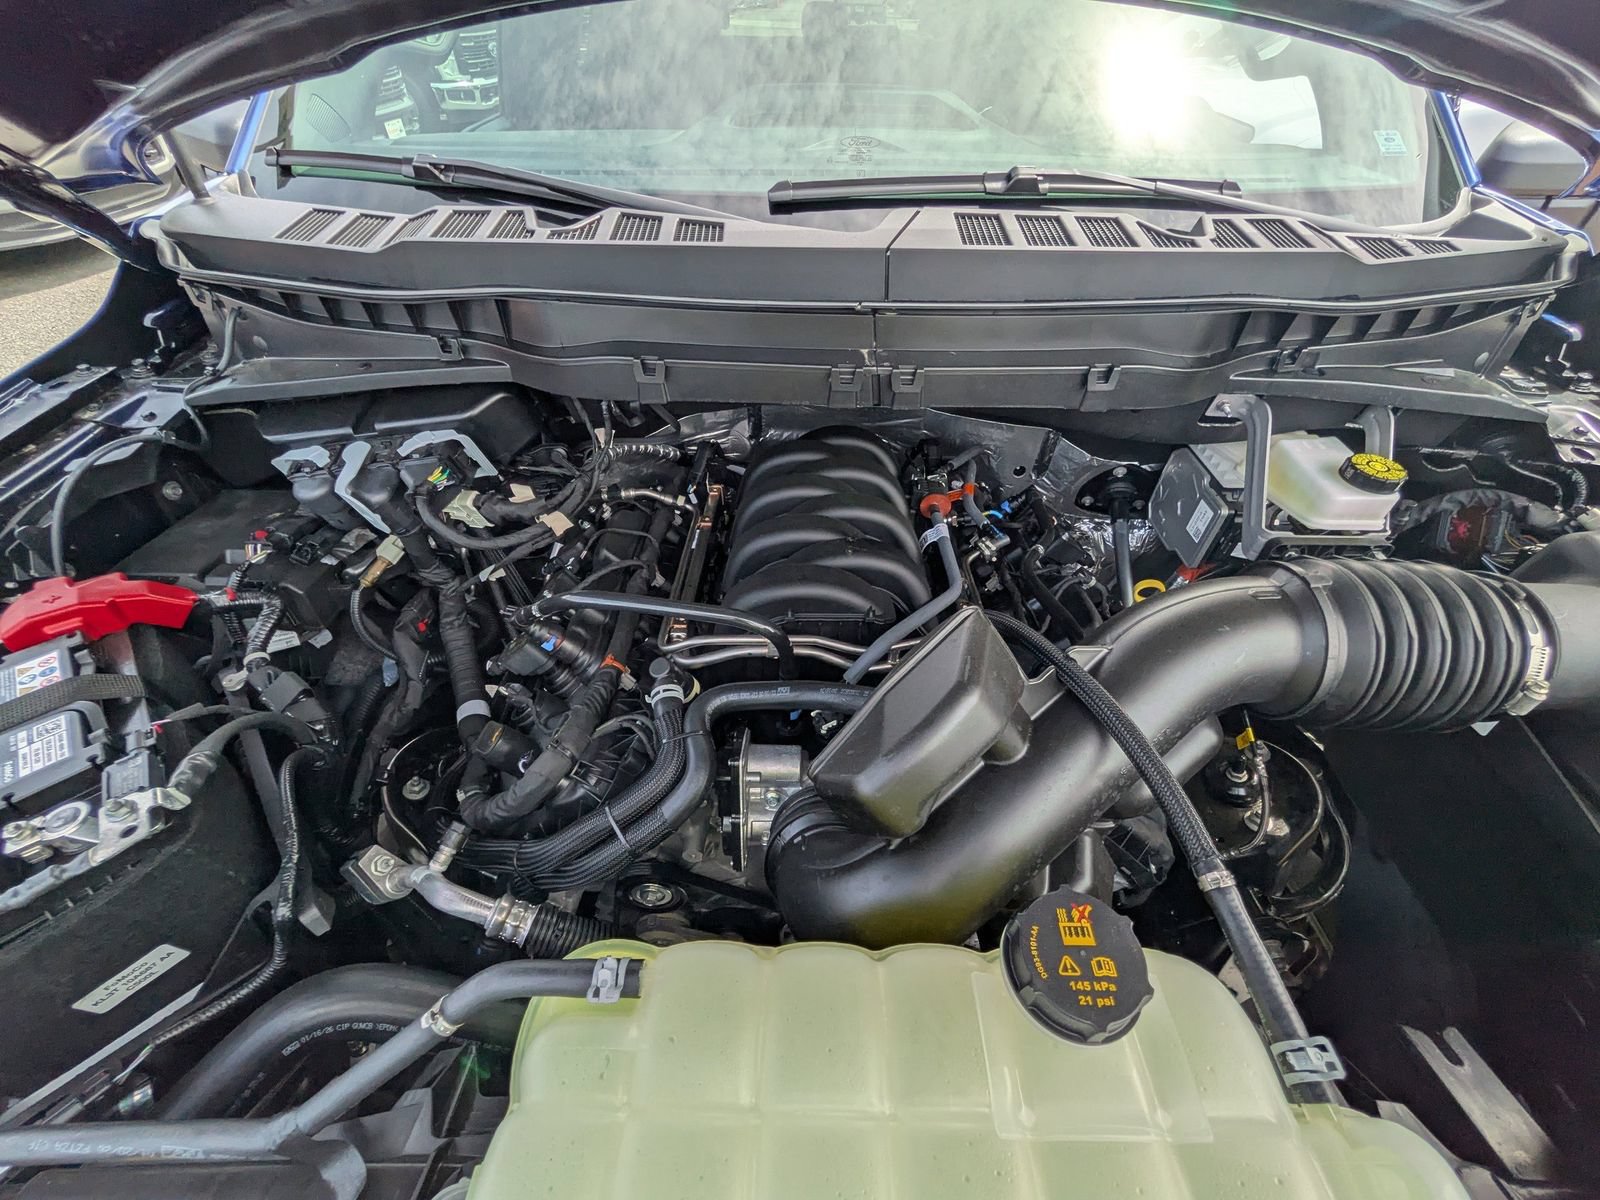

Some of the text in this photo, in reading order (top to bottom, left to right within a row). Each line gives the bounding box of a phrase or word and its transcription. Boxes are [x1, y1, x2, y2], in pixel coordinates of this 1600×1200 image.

[160, 951, 175, 962] AA
[103, 961, 148, 990] FoMoCo
[1069, 981, 1117, 992] 145 kPa
[1078, 995, 1115, 1008] 21 psi
